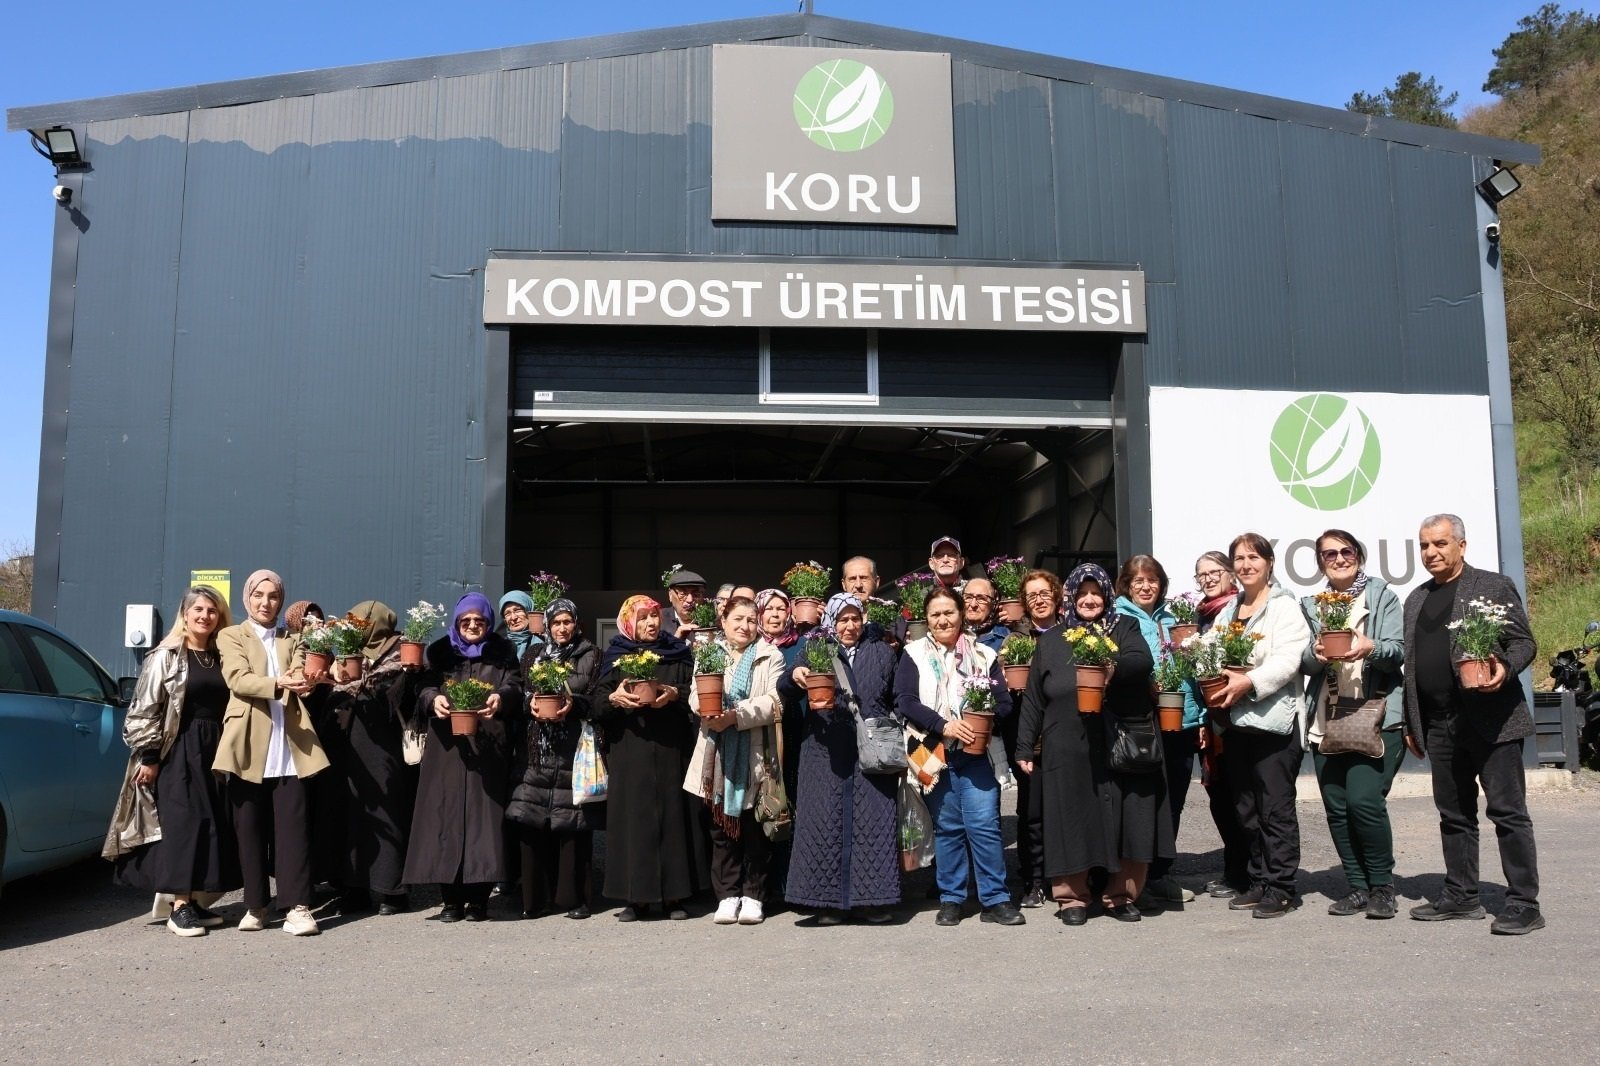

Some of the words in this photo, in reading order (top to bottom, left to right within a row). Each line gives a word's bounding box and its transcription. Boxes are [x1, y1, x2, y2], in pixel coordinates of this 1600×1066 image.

[765, 171, 921, 214] KORU
[506, 277, 763, 318] KOMPOST
[779, 272, 967, 321] ÜRETİM
[981, 278, 1133, 325] TESİSİ
